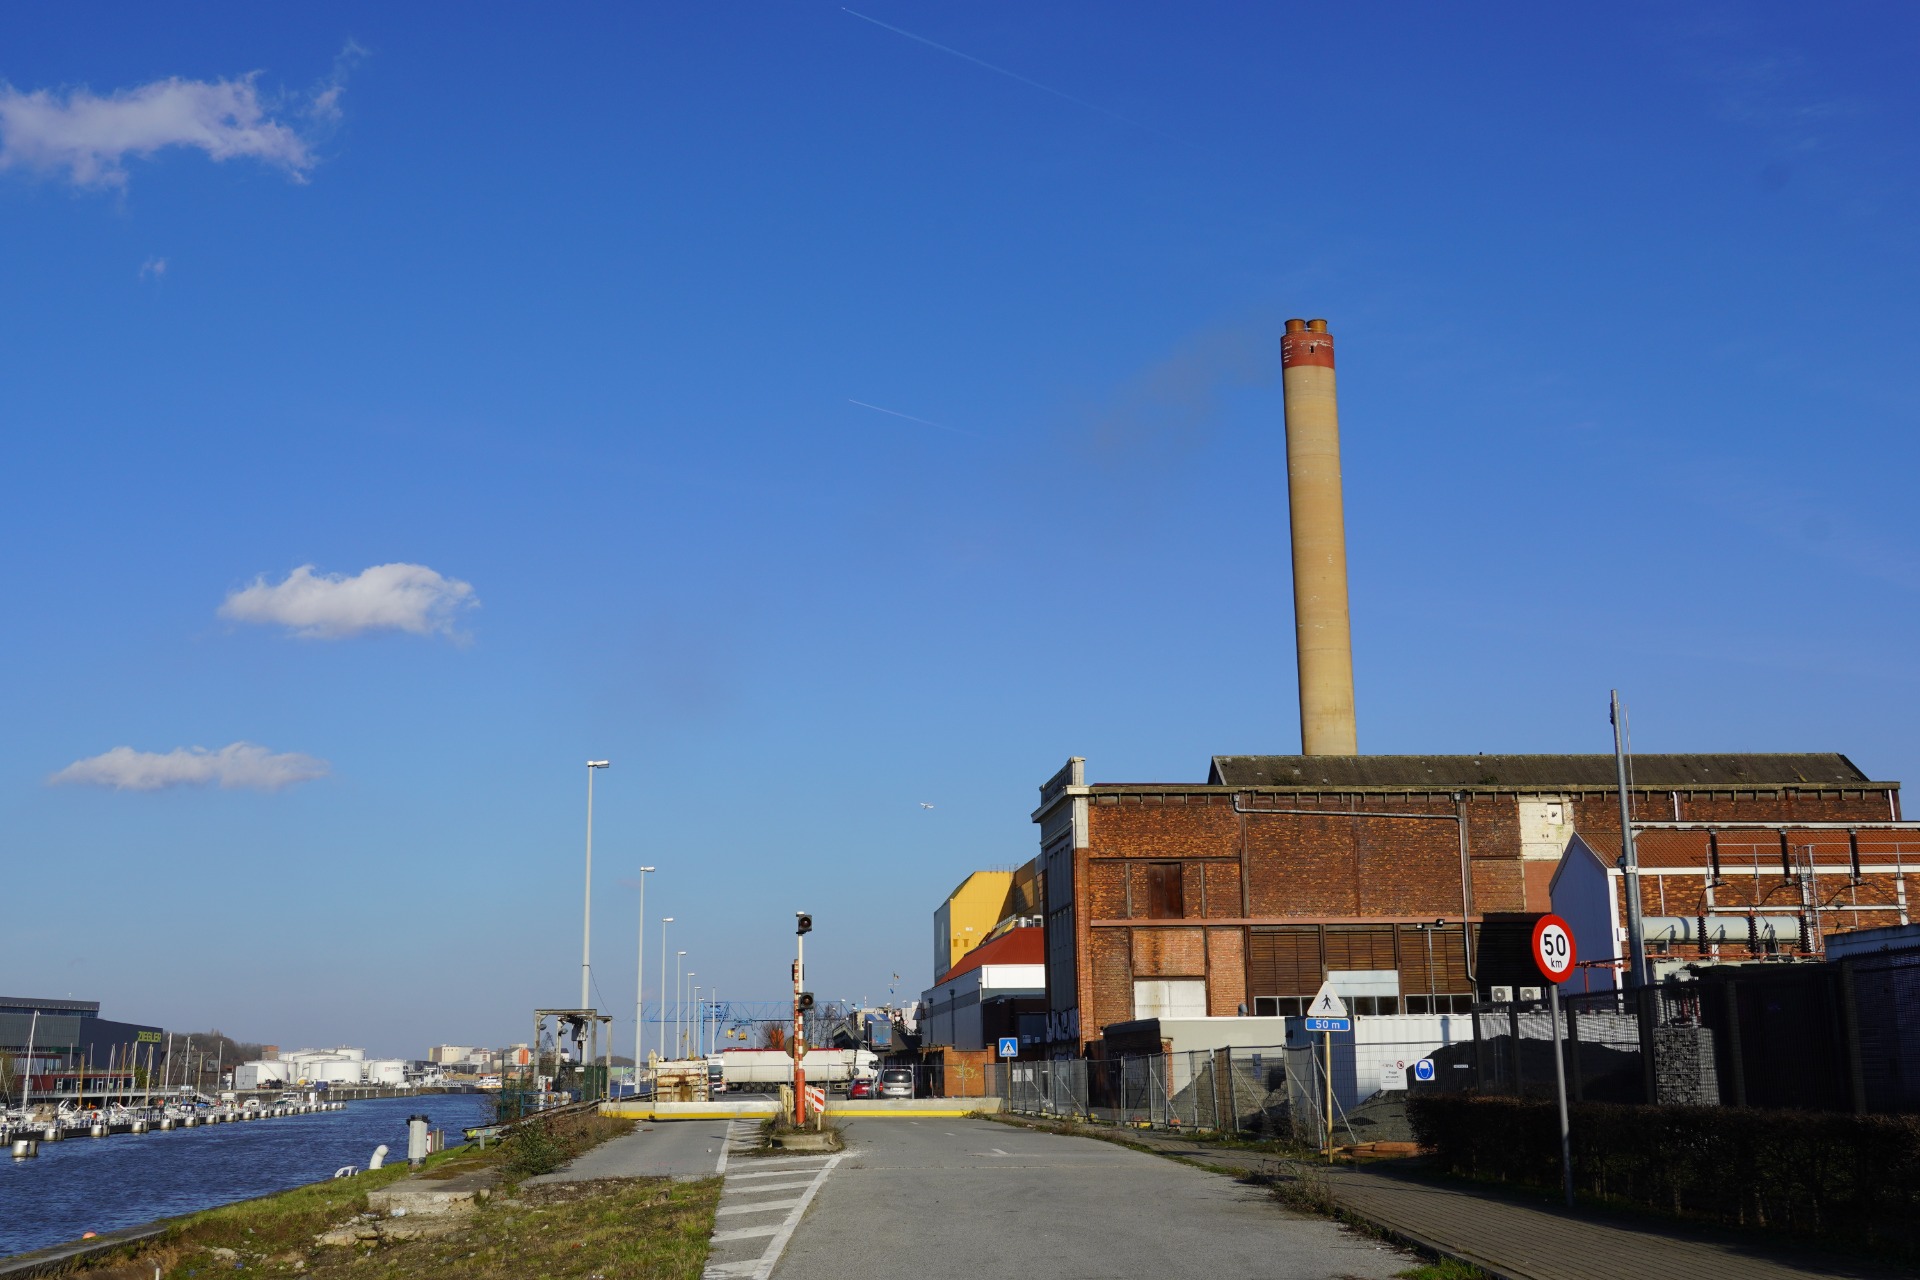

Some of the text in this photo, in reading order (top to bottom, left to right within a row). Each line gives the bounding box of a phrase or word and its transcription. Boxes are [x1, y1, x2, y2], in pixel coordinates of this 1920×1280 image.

[1544, 934, 1566, 956] 50
[1550, 957, 1563, 968] km
[1315, 1020, 1329, 1029] 50
[138, 1031, 162, 1043] ZIEGLER
